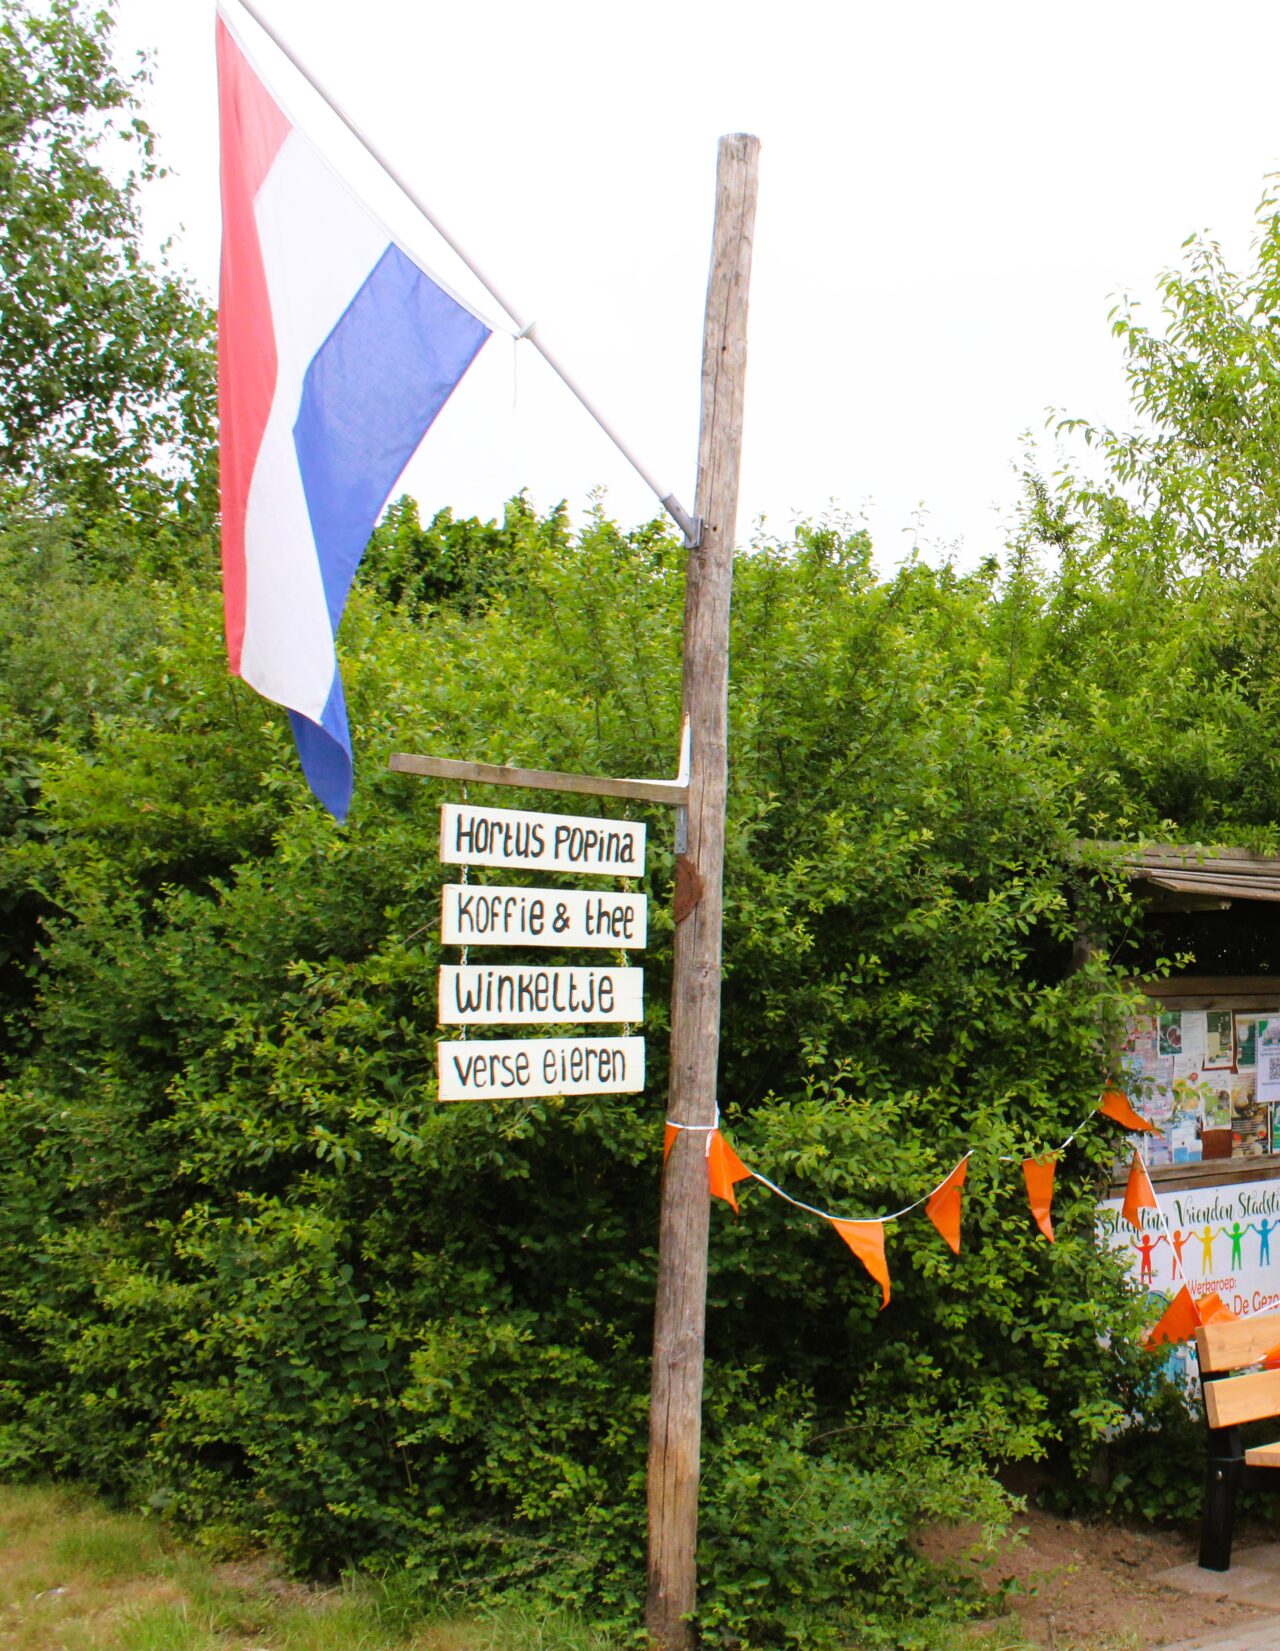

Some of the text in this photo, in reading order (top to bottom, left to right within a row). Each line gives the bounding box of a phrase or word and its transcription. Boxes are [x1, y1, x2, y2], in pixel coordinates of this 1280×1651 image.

[456, 813, 545, 858] Hortus
[458, 892, 635, 939] Koffie & thee
[456, 971, 614, 1014] Winkeltje
[453, 1047, 626, 1088] verse eieren
[1174, 1195, 1233, 1227] Vrienden
[1234, 1294, 1249, 1315] De
